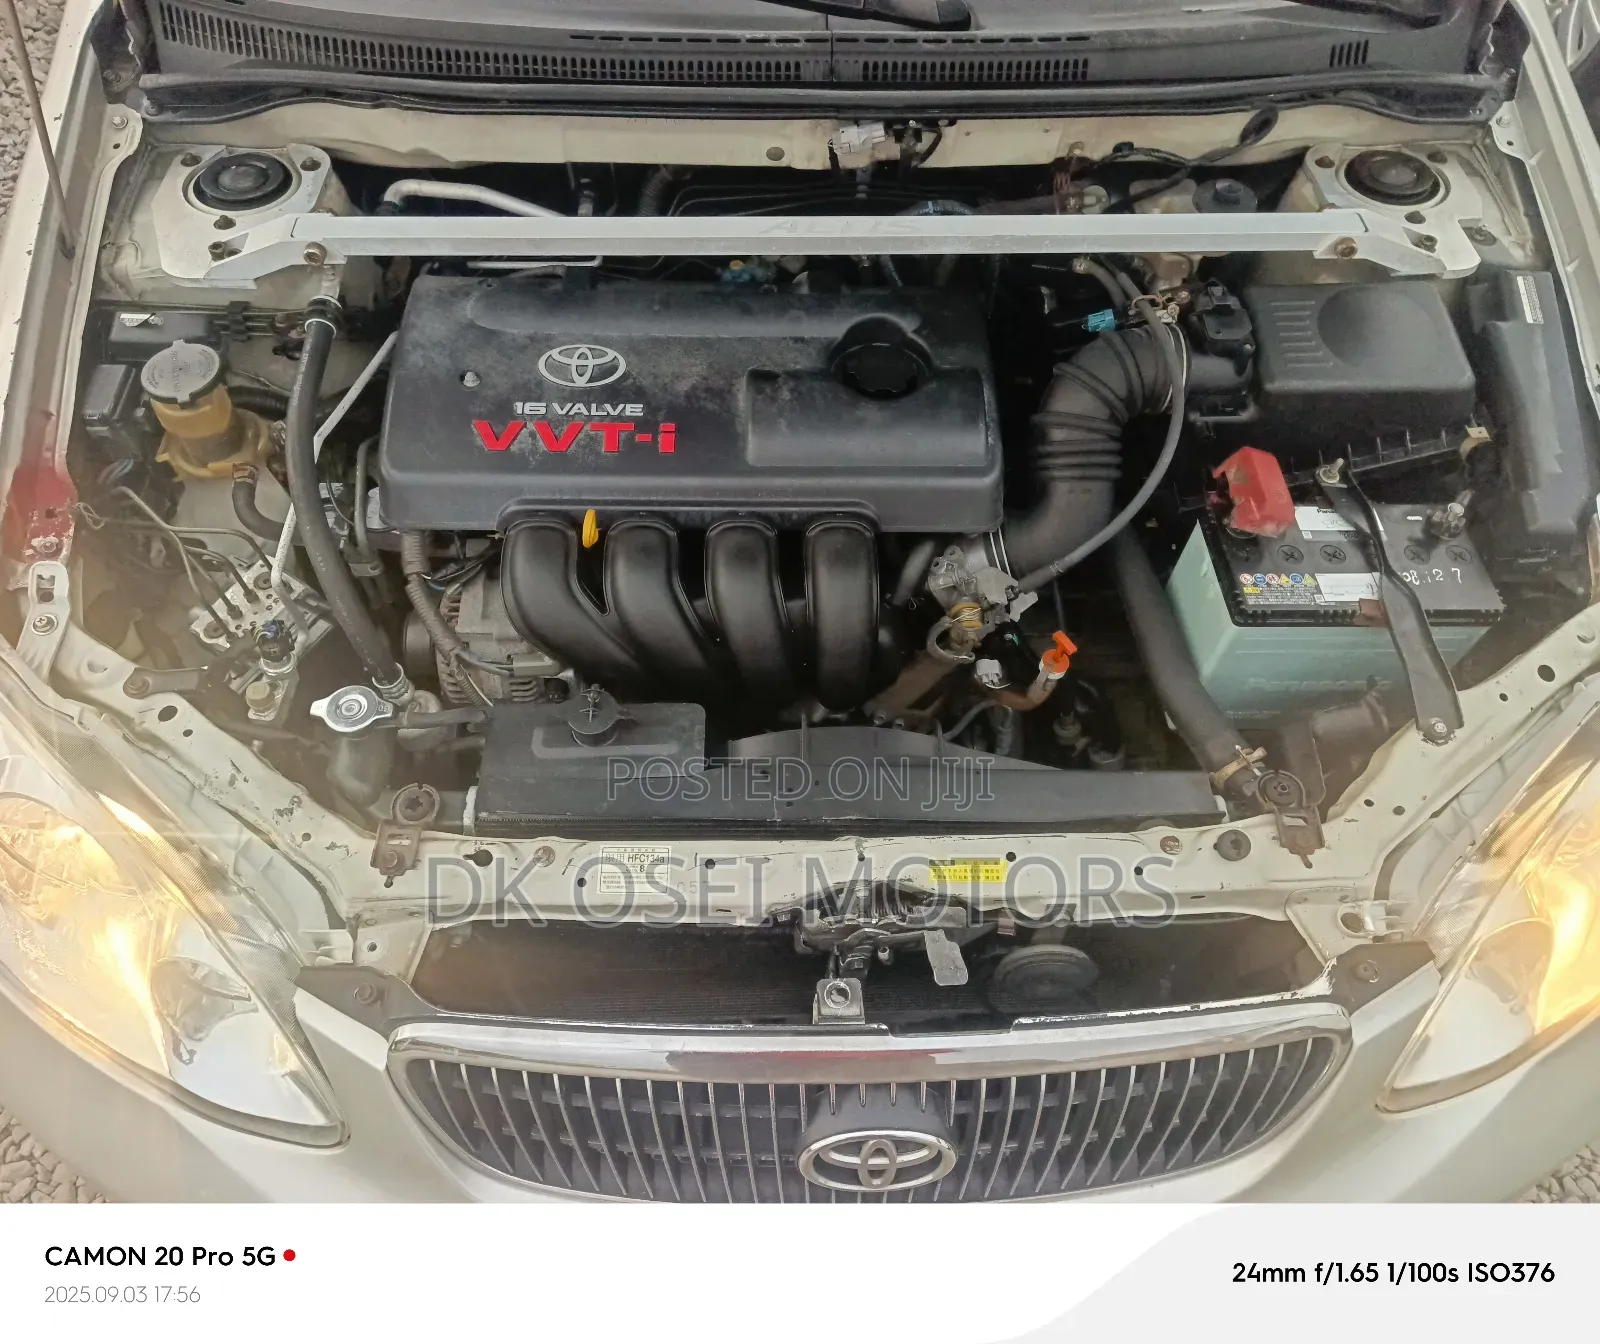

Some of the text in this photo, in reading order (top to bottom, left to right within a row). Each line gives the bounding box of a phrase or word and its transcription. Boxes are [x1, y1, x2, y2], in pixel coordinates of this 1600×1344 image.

[514, 402, 644, 416] 16 VALVE
[472, 419, 677, 454] VVT-i
[627, 853, 665, 863] HFC134a
